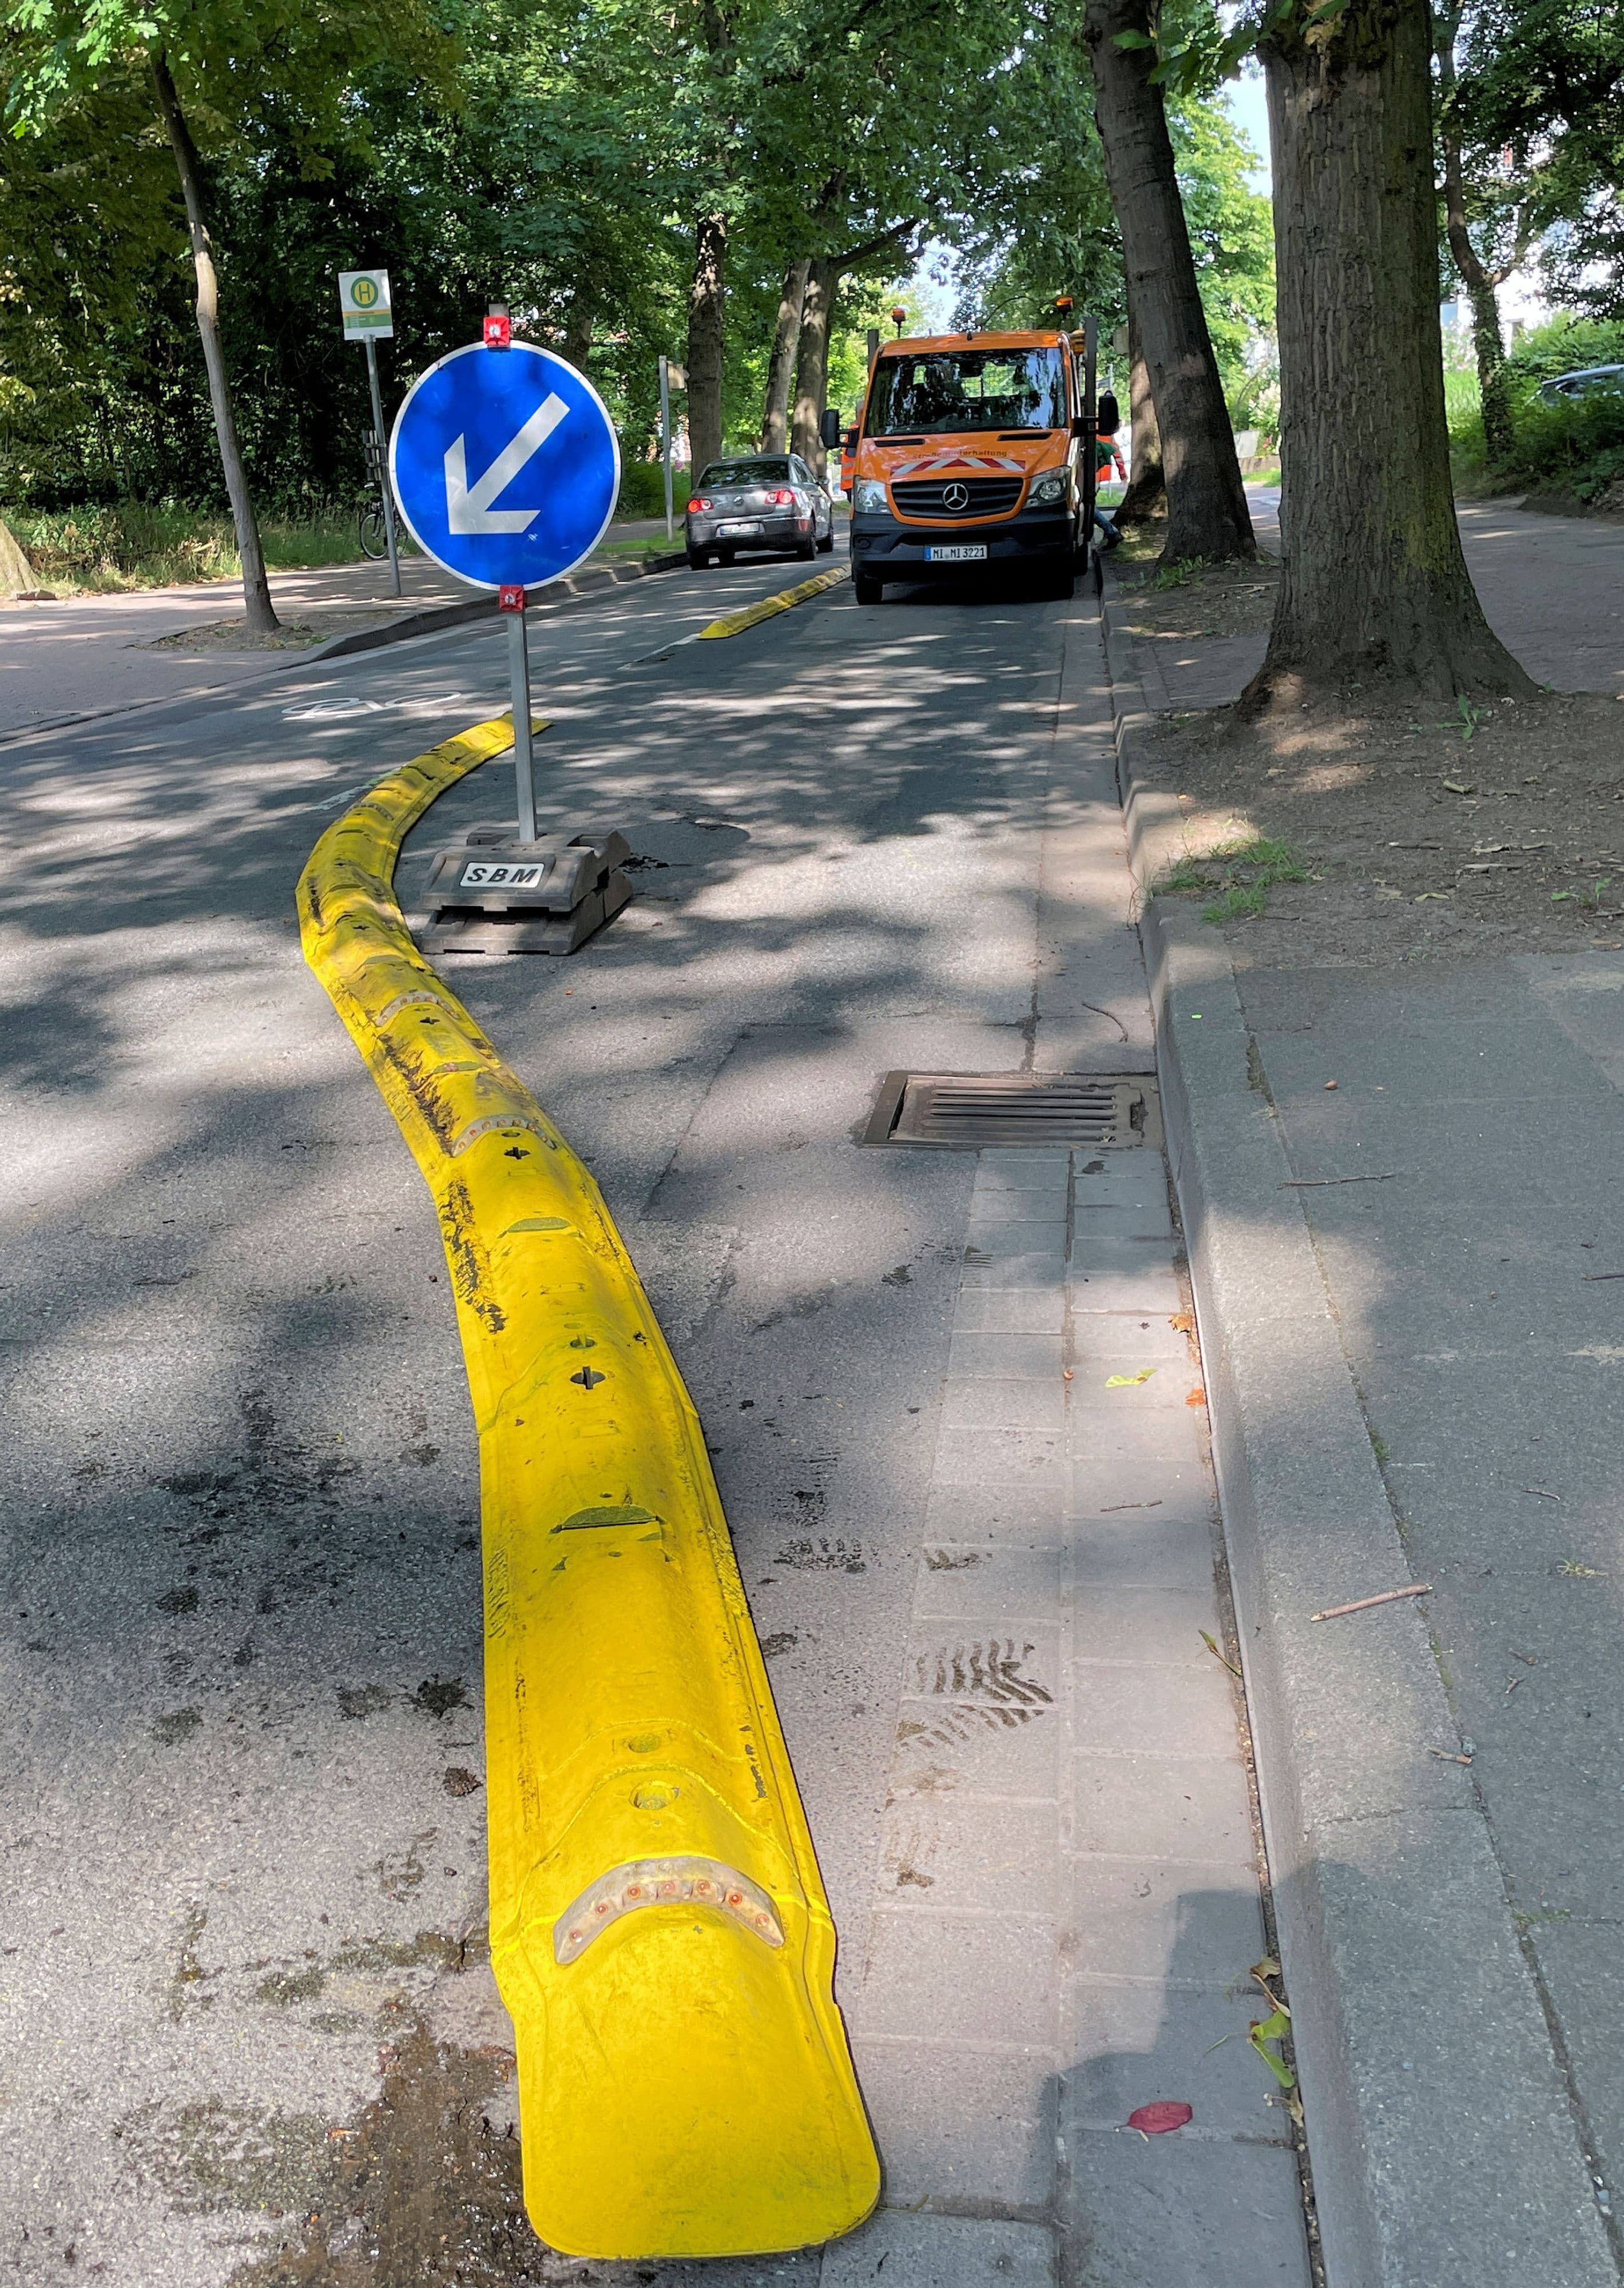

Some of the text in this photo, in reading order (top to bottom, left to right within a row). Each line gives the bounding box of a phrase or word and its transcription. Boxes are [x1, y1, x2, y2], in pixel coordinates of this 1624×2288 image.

[359, 283, 371, 301] H
[913, 450, 1007, 459] Strßenunterhaltung
[933, 547, 984, 558] MI MI 3221
[467, 868, 538, 883] SBM
